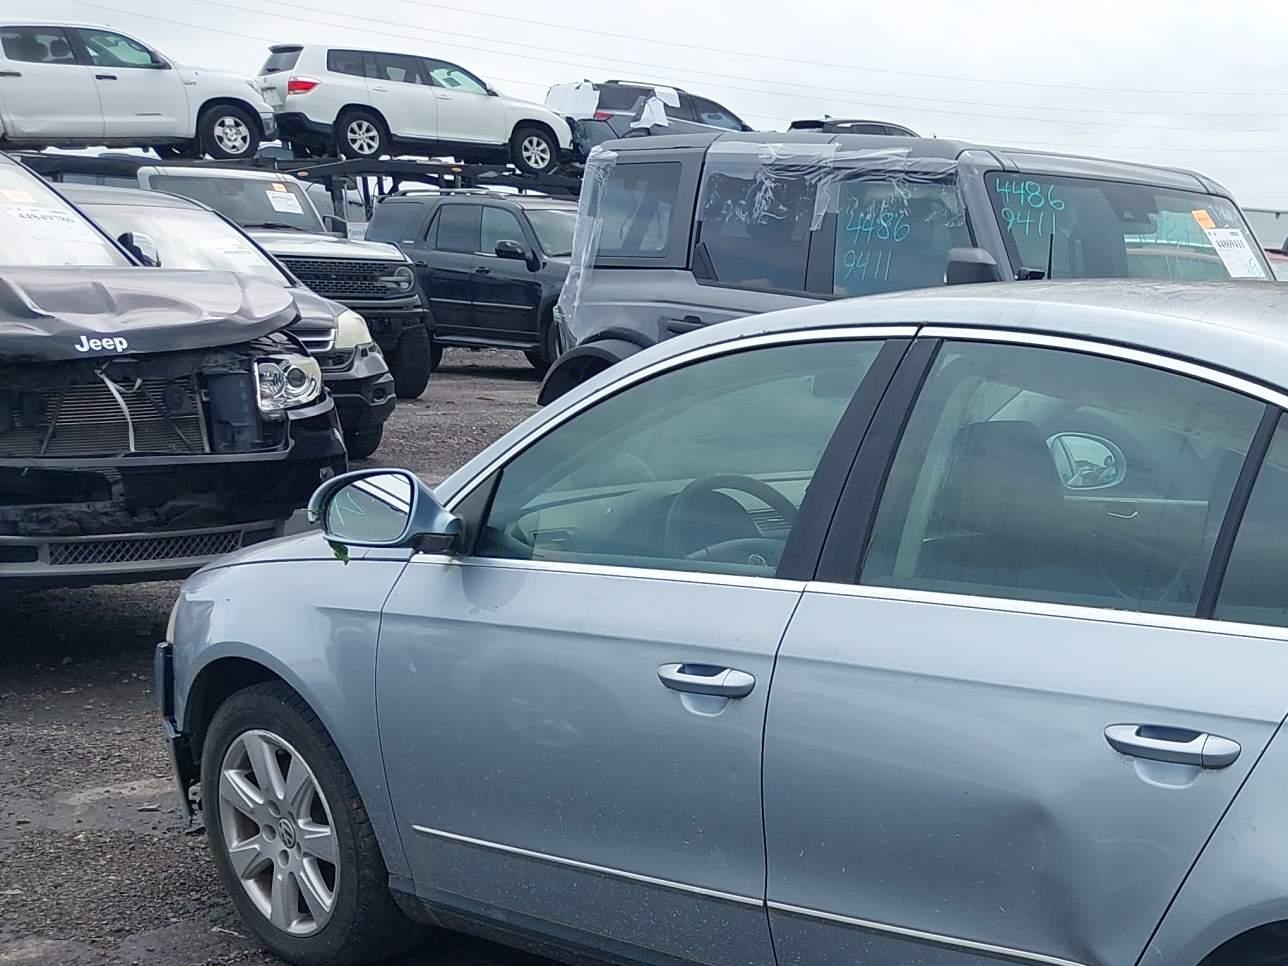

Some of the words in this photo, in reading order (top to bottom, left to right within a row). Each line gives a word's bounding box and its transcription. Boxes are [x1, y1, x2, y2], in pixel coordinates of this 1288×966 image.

[996, 177, 1065, 211] 4486
[846, 211, 911, 245] 4486
[1001, 207, 1056, 237] 9411
[843, 249, 894, 281] 9411
[74, 335, 129, 353] Jeep
